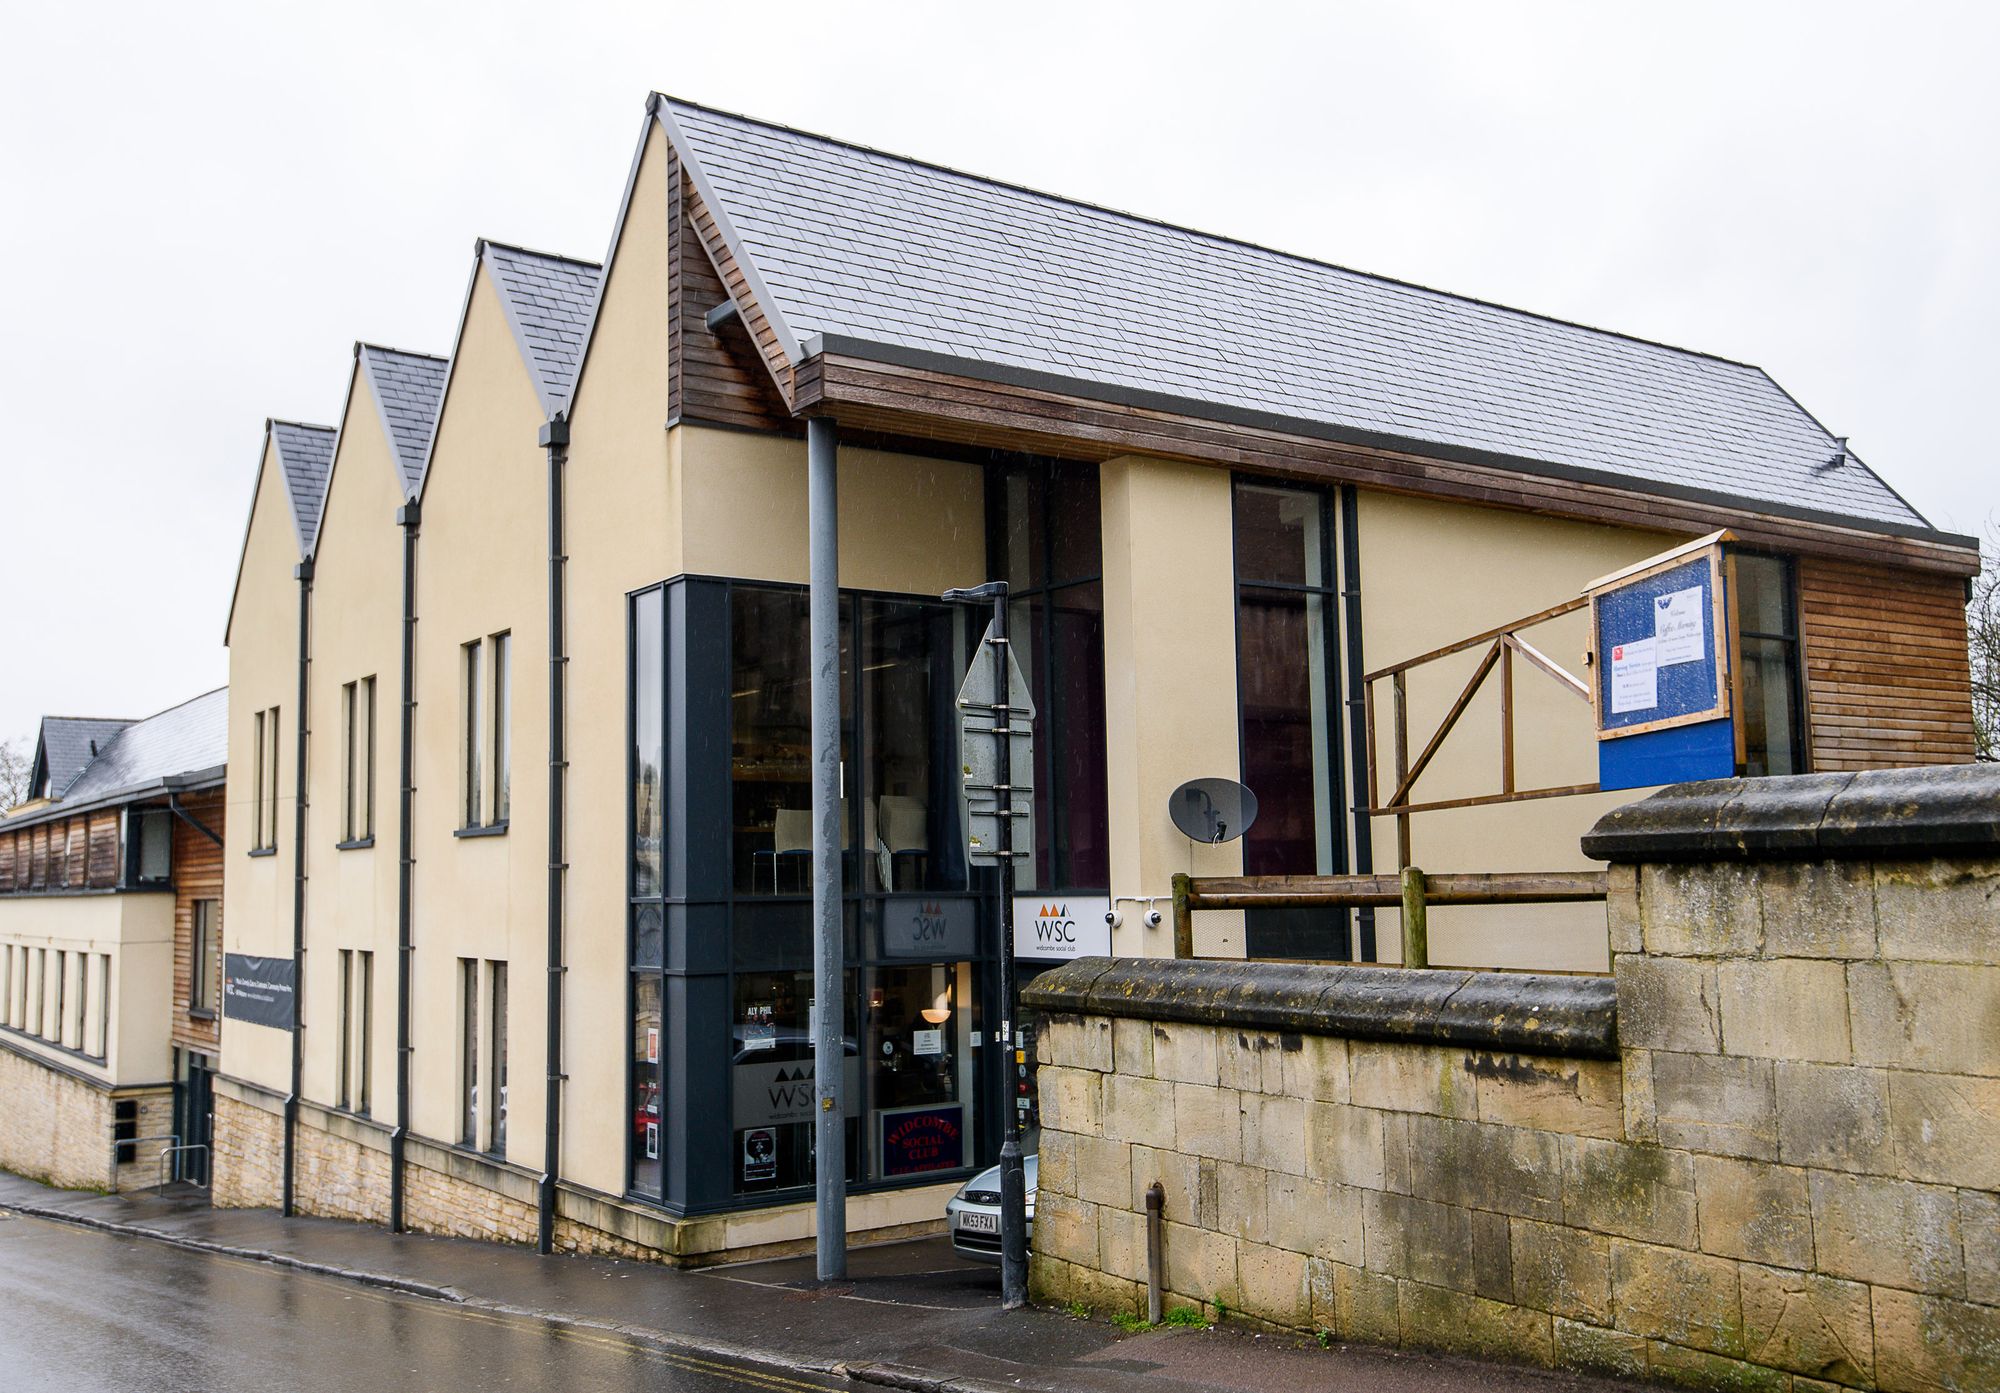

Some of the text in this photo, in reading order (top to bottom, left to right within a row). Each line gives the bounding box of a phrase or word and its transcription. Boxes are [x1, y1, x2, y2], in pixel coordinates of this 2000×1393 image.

[1035, 920, 1076, 942] WSC
[768, 1084, 816, 1109] WS
[887, 1115, 959, 1145] WIDCOMBE
[902, 1135, 944, 1149] SOCIAL
[908, 1146, 940, 1160] CLUB
[979, 1215, 994, 1230] FXA
